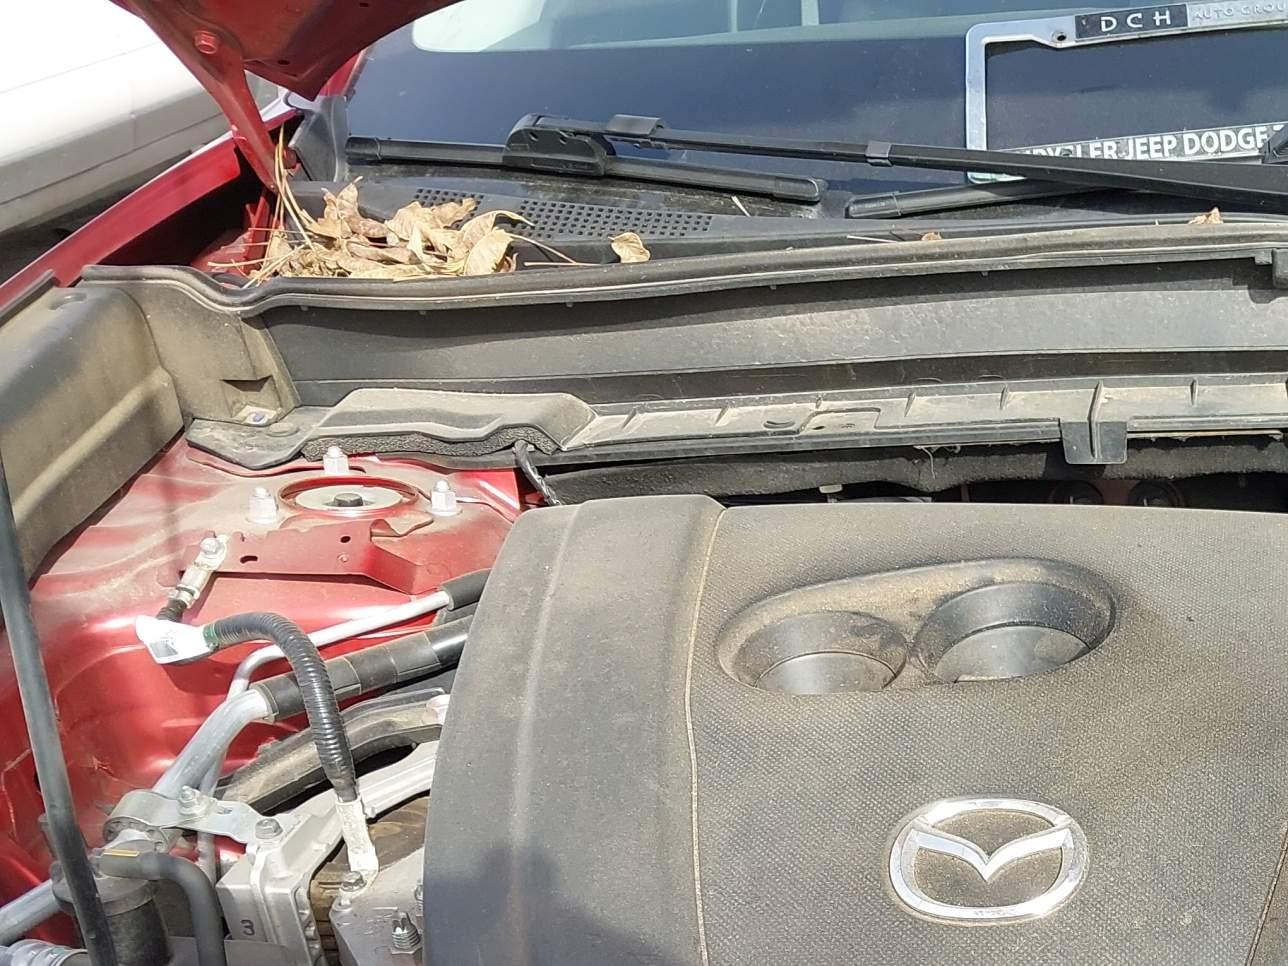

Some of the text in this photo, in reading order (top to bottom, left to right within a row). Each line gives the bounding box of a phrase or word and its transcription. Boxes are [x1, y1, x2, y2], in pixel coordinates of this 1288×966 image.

[1100, 10, 1171, 32] DCH
[1192, 8, 1234, 20] AUTO
[1119, 135, 1177, 159] JEEP
[241, 919, 255, 936] 3
